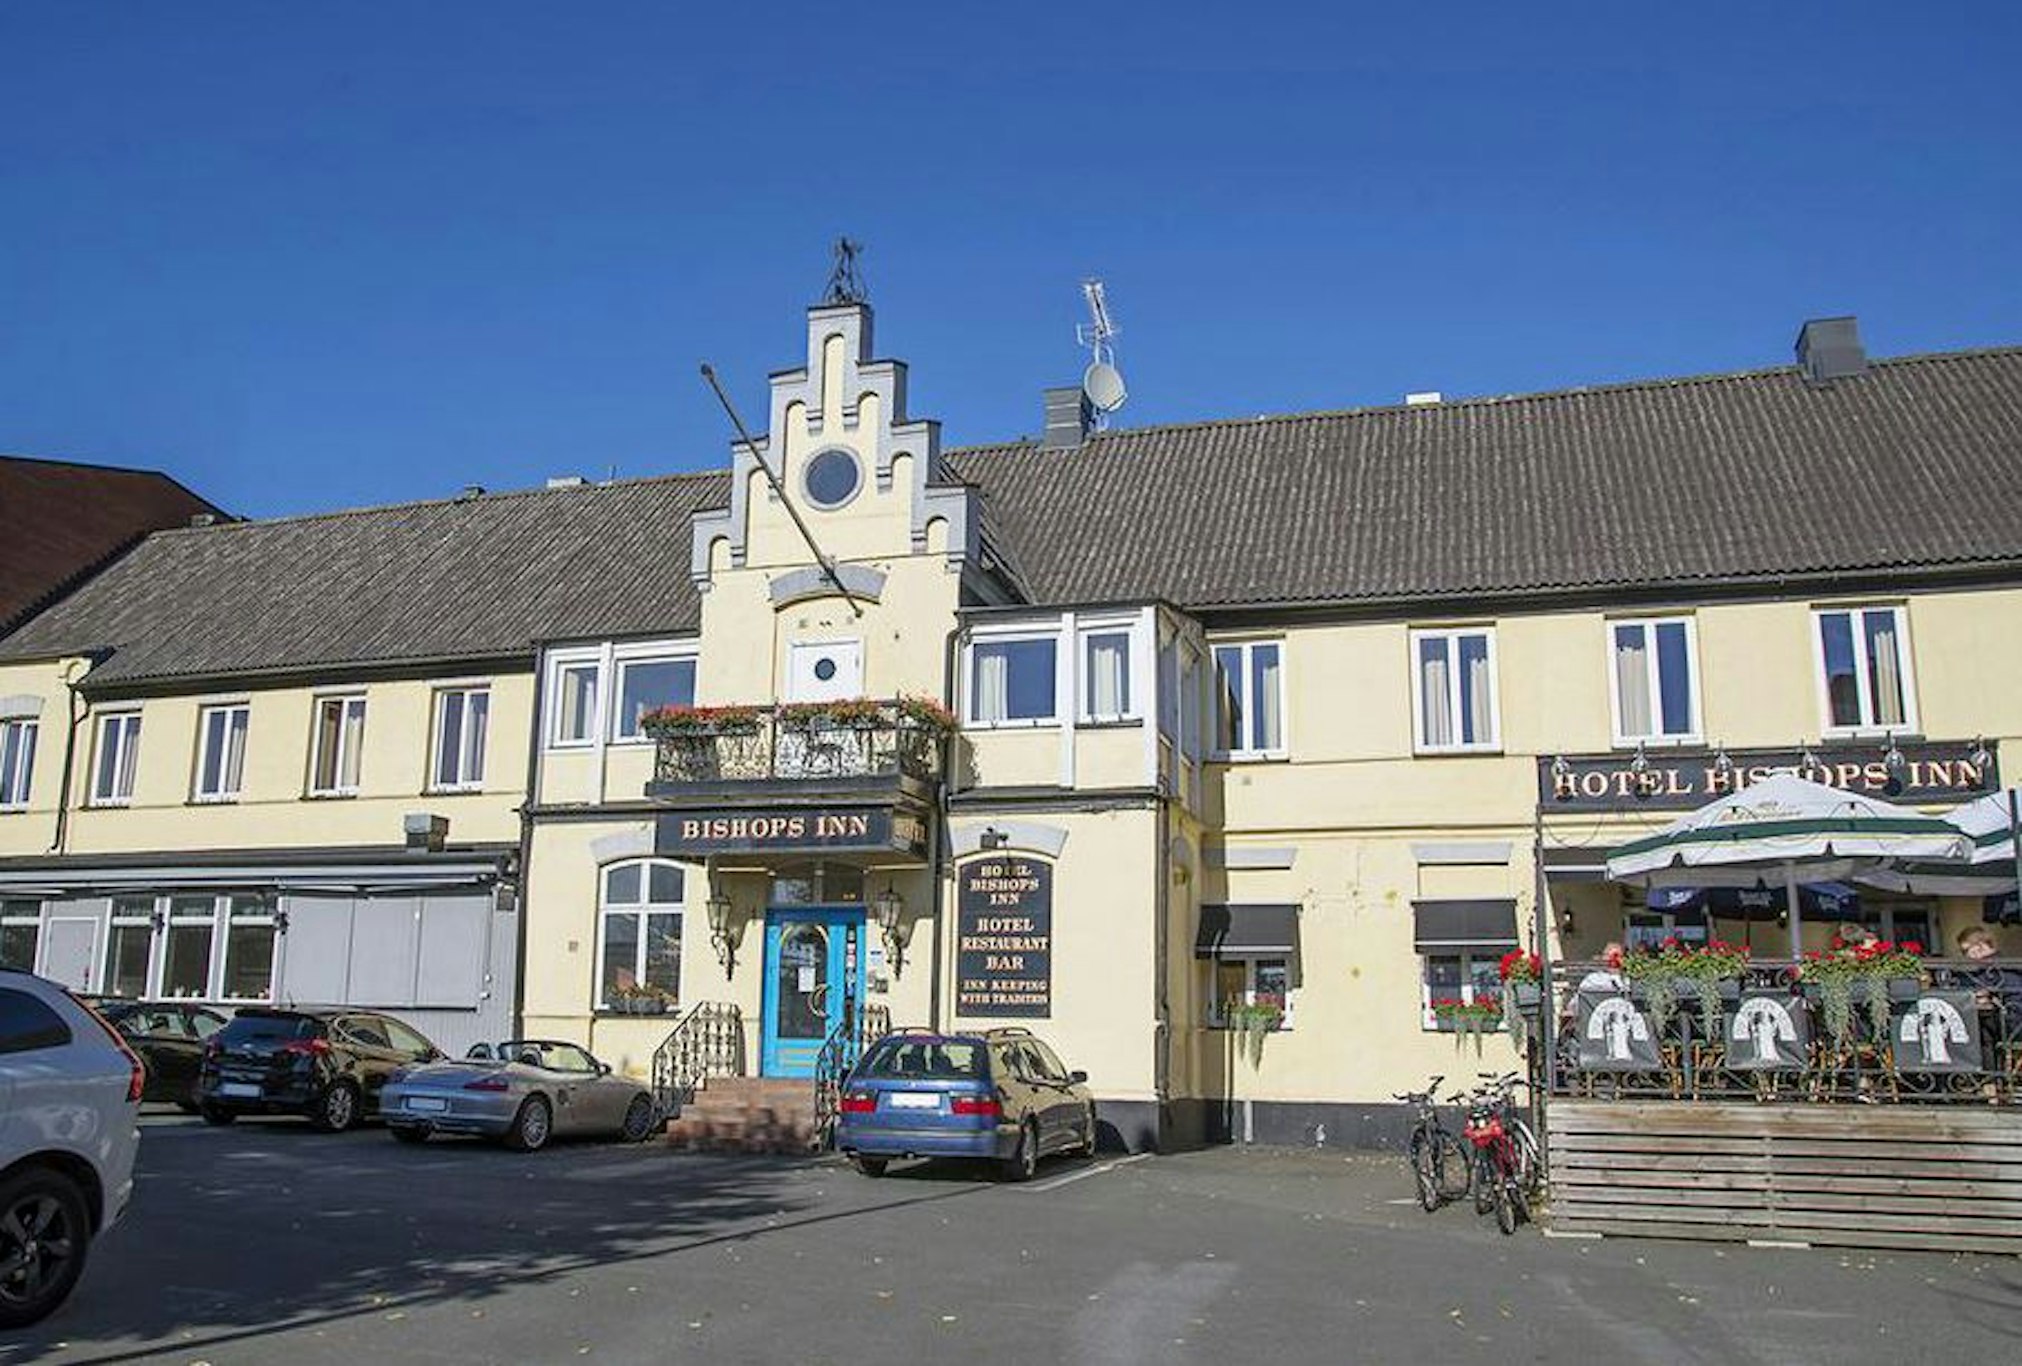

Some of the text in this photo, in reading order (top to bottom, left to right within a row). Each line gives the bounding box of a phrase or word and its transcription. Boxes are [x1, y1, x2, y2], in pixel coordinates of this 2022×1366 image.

[1553, 760, 1984, 797] HOTEL BISOPS INN
[683, 816, 868, 839] BISHOPS INN
[970, 878, 1039, 891] BISHOPS
[990, 893, 1020, 905] INN
[977, 918, 1035, 932] HOTEL
[961, 937, 1048, 950] RESTAURANT
[986, 956, 1024, 970] BAR
[963, 980, 986, 990] INN
